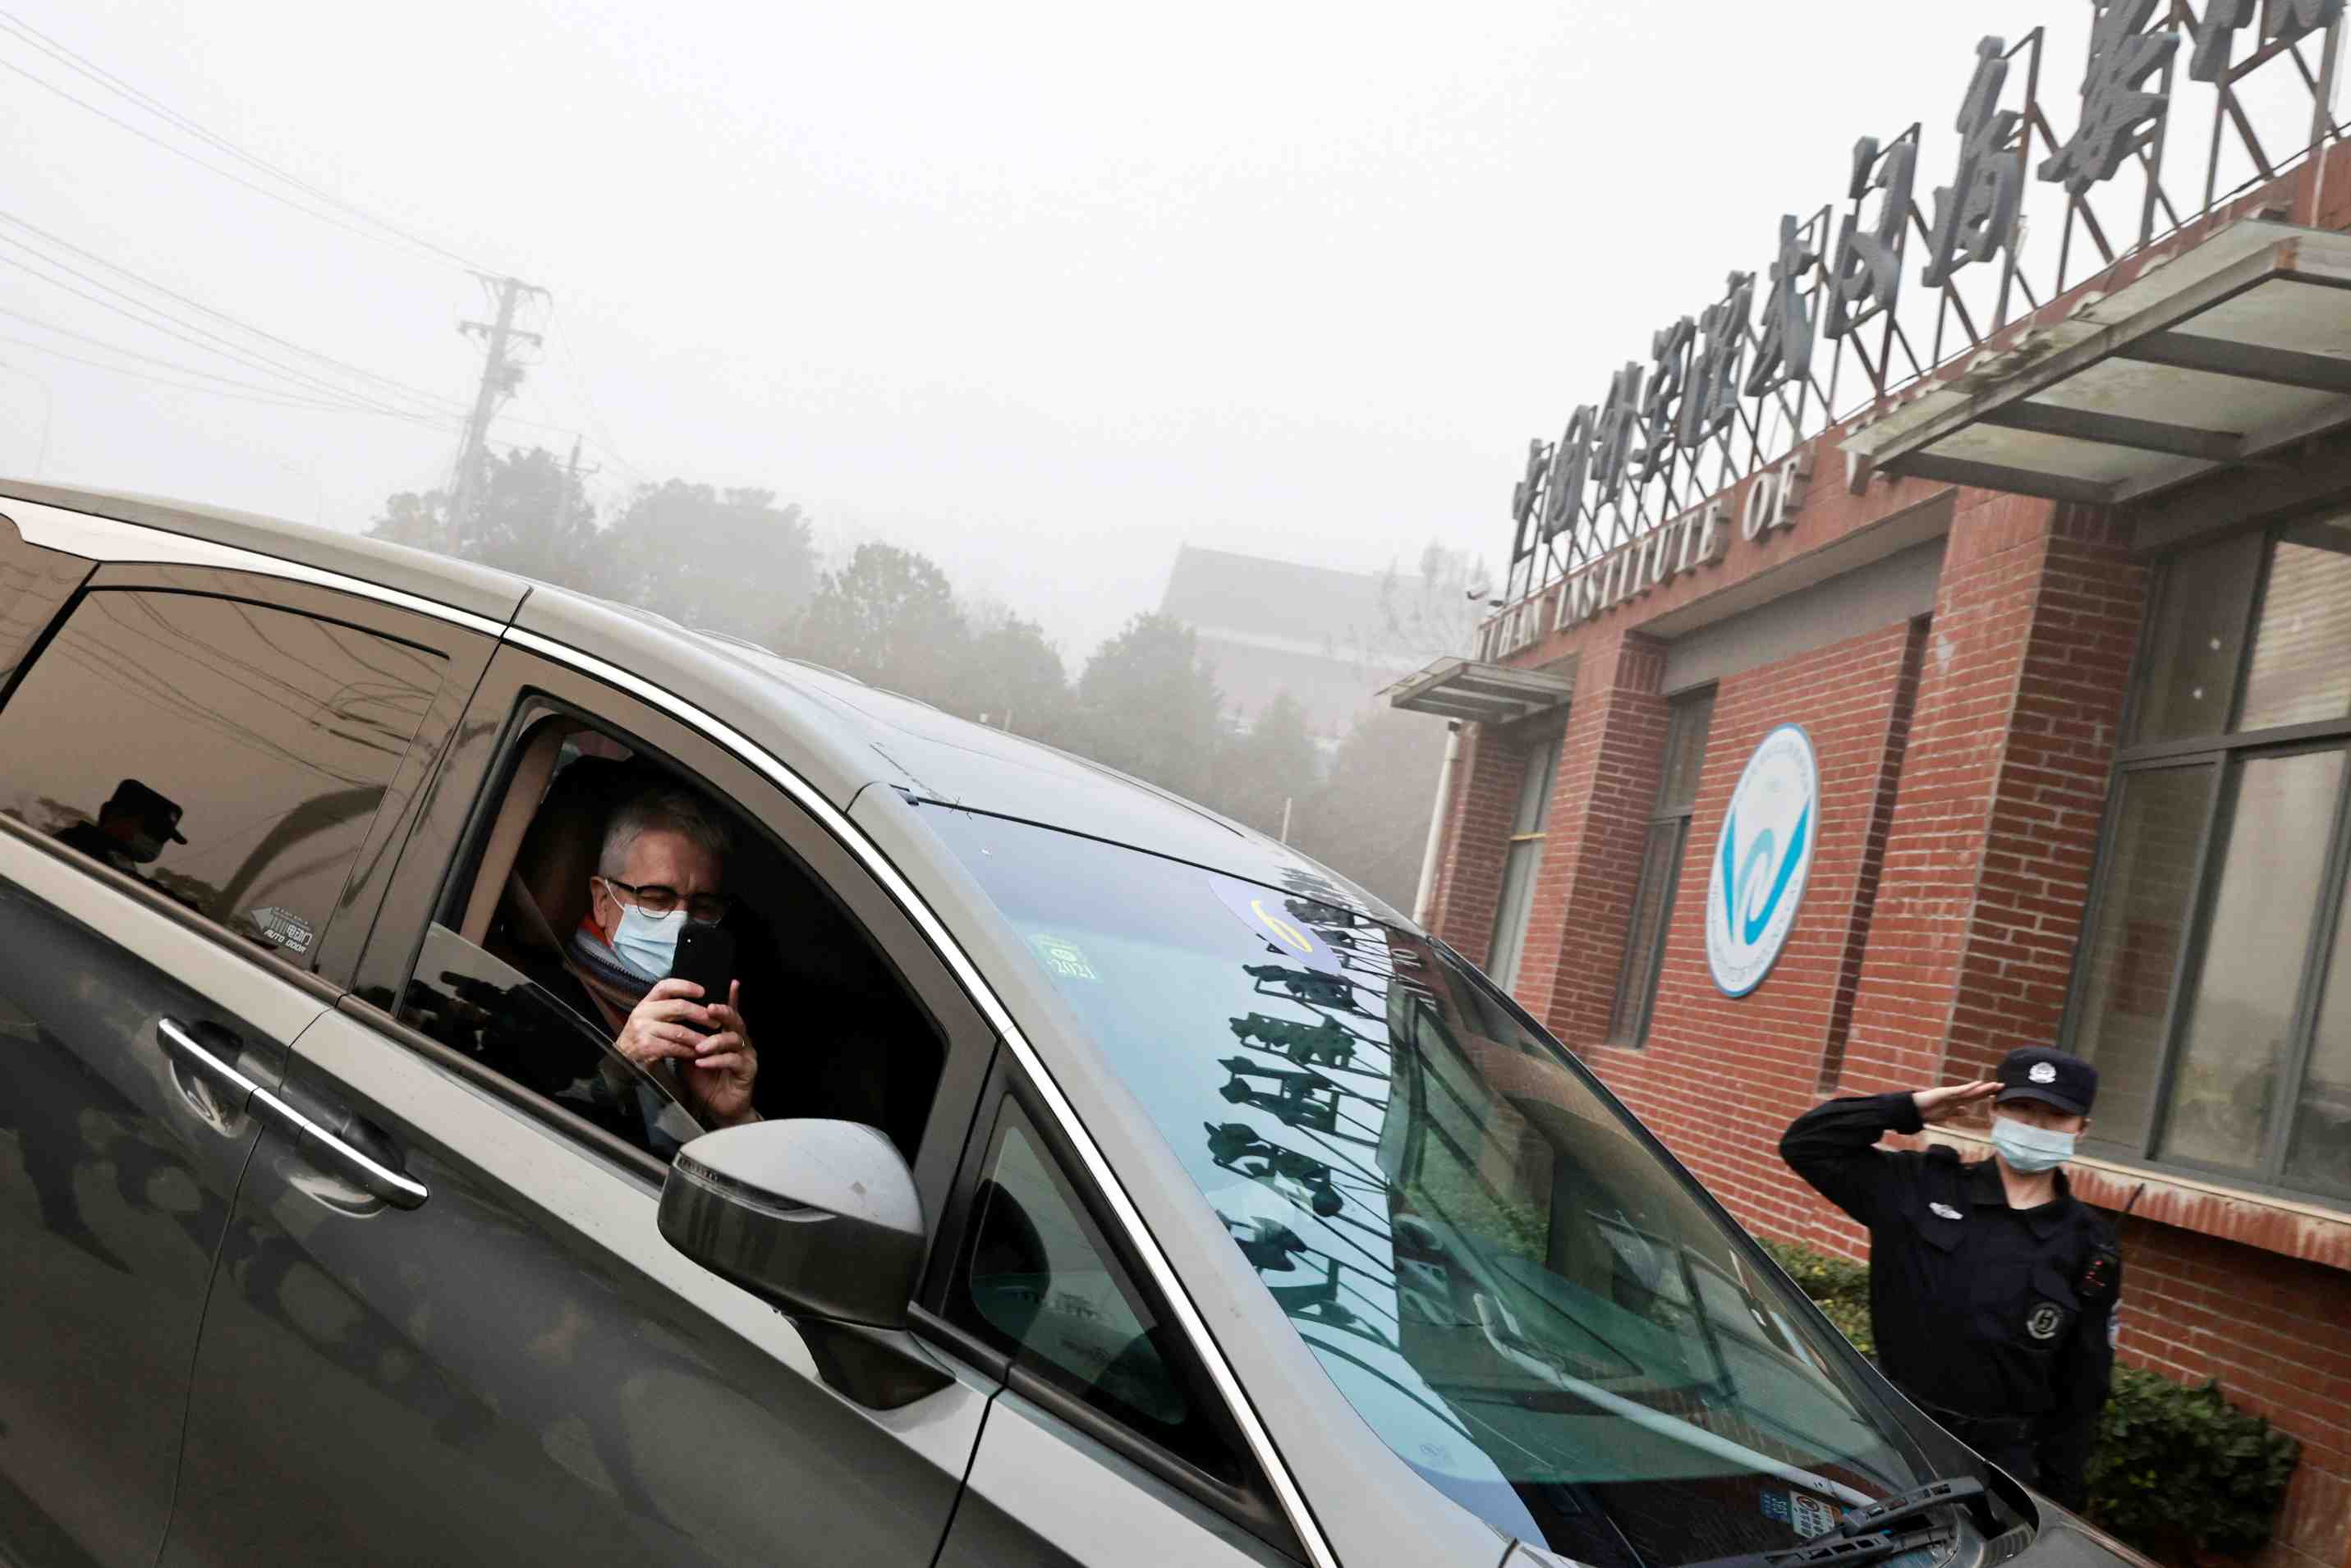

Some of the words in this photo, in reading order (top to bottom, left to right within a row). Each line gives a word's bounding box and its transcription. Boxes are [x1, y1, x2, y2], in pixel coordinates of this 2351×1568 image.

[1552, 497, 1724, 632] INSTITUTE
[1741, 453, 1806, 541] OF
[264, 928, 286, 943] AUTO
[284, 938, 307, 954] DOOR
